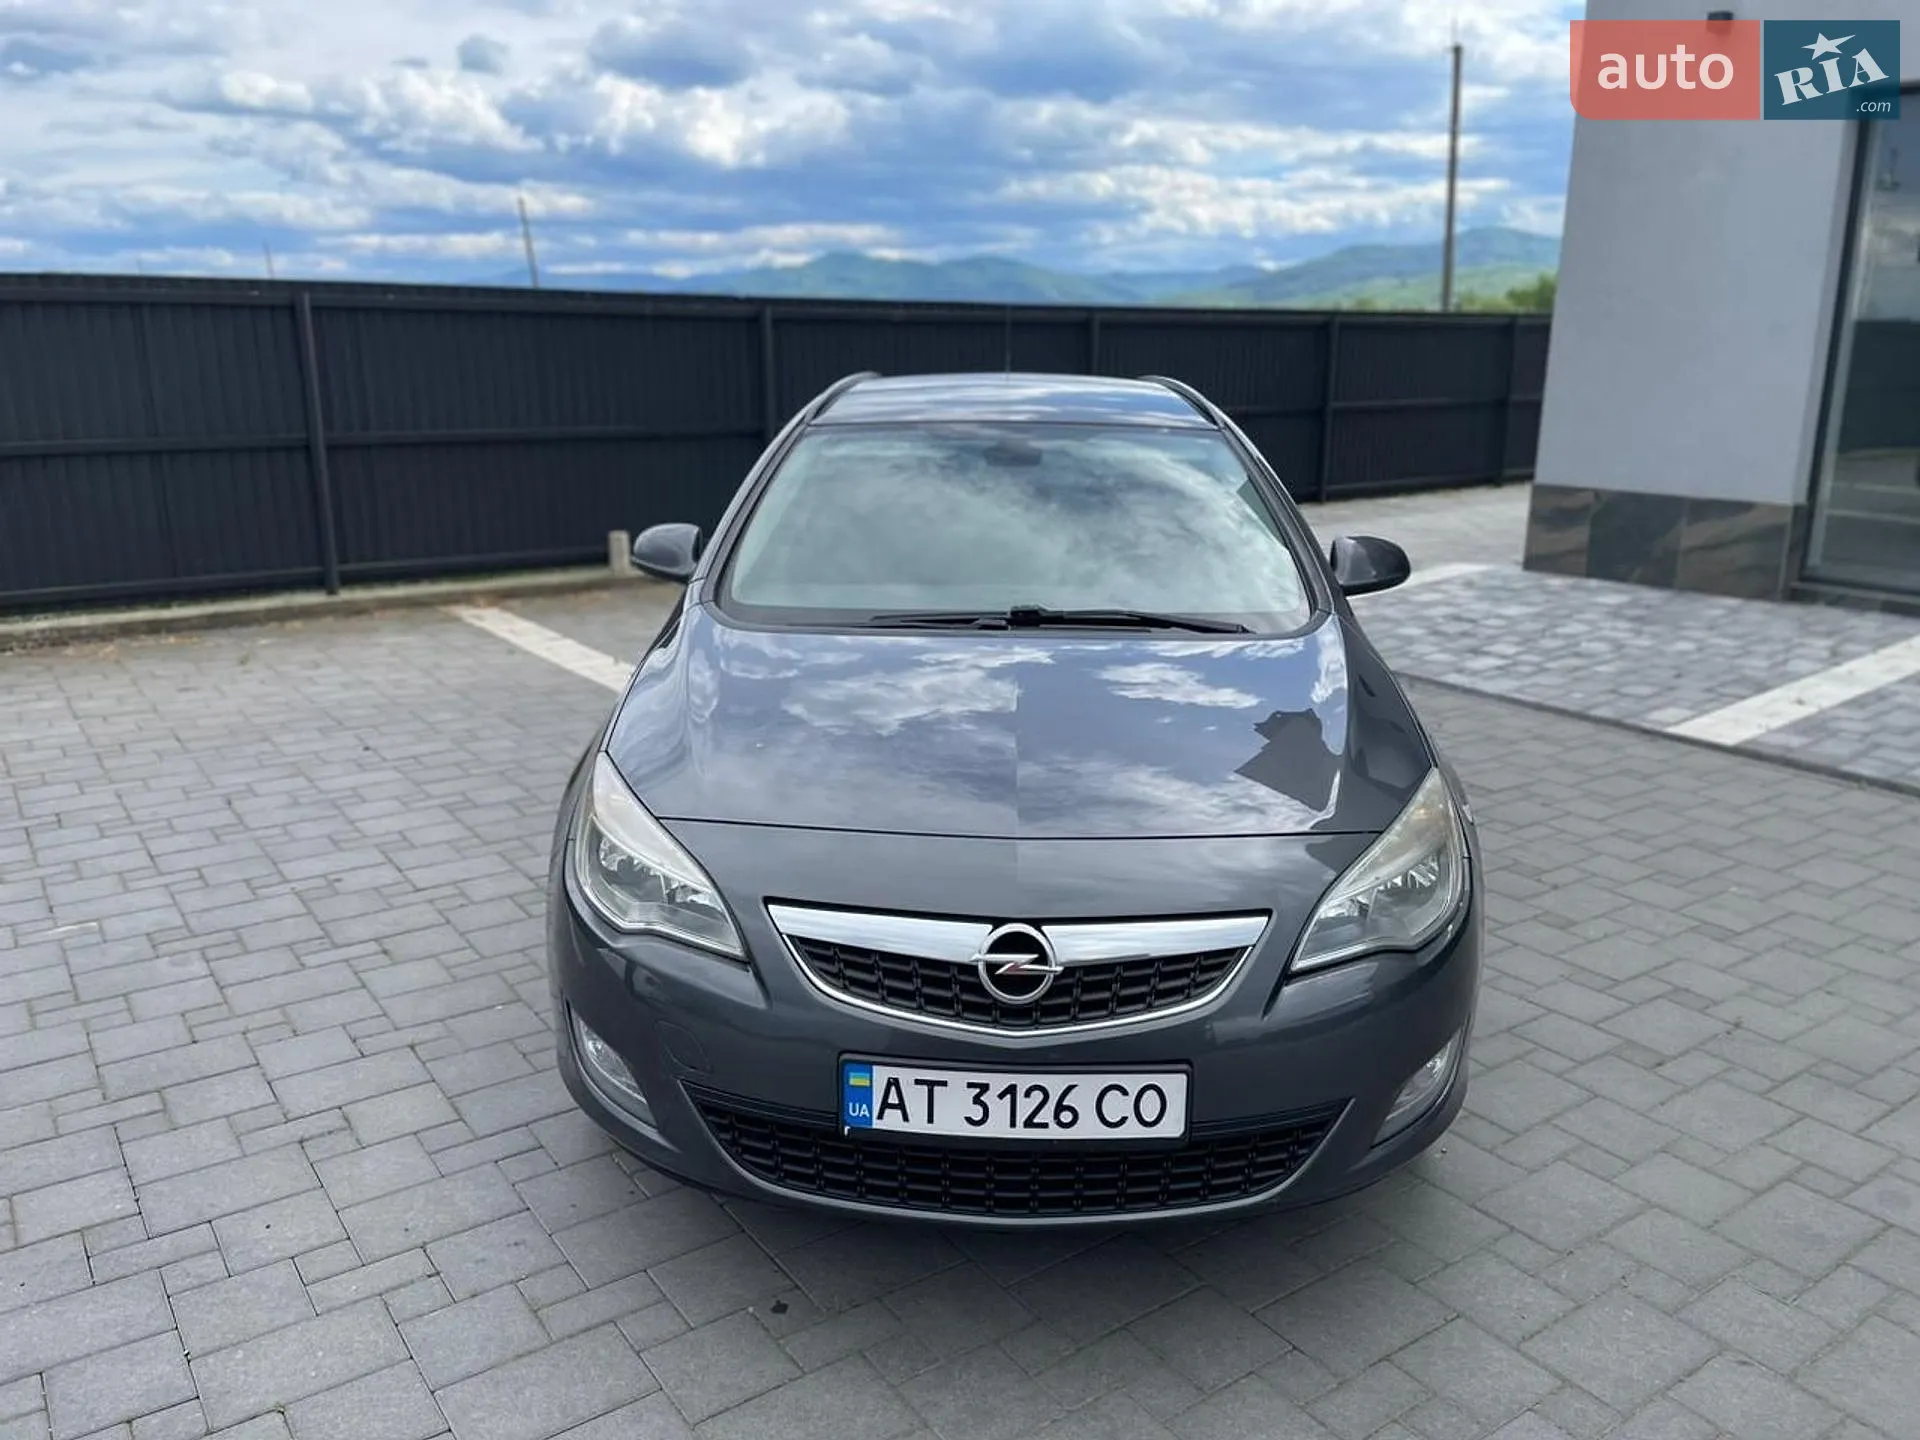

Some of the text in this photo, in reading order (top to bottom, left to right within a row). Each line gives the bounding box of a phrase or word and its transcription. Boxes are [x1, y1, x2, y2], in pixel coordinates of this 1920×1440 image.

[848, 1102, 871, 1118] UA
[876, 1076, 1168, 1130] AT 3126 CO
